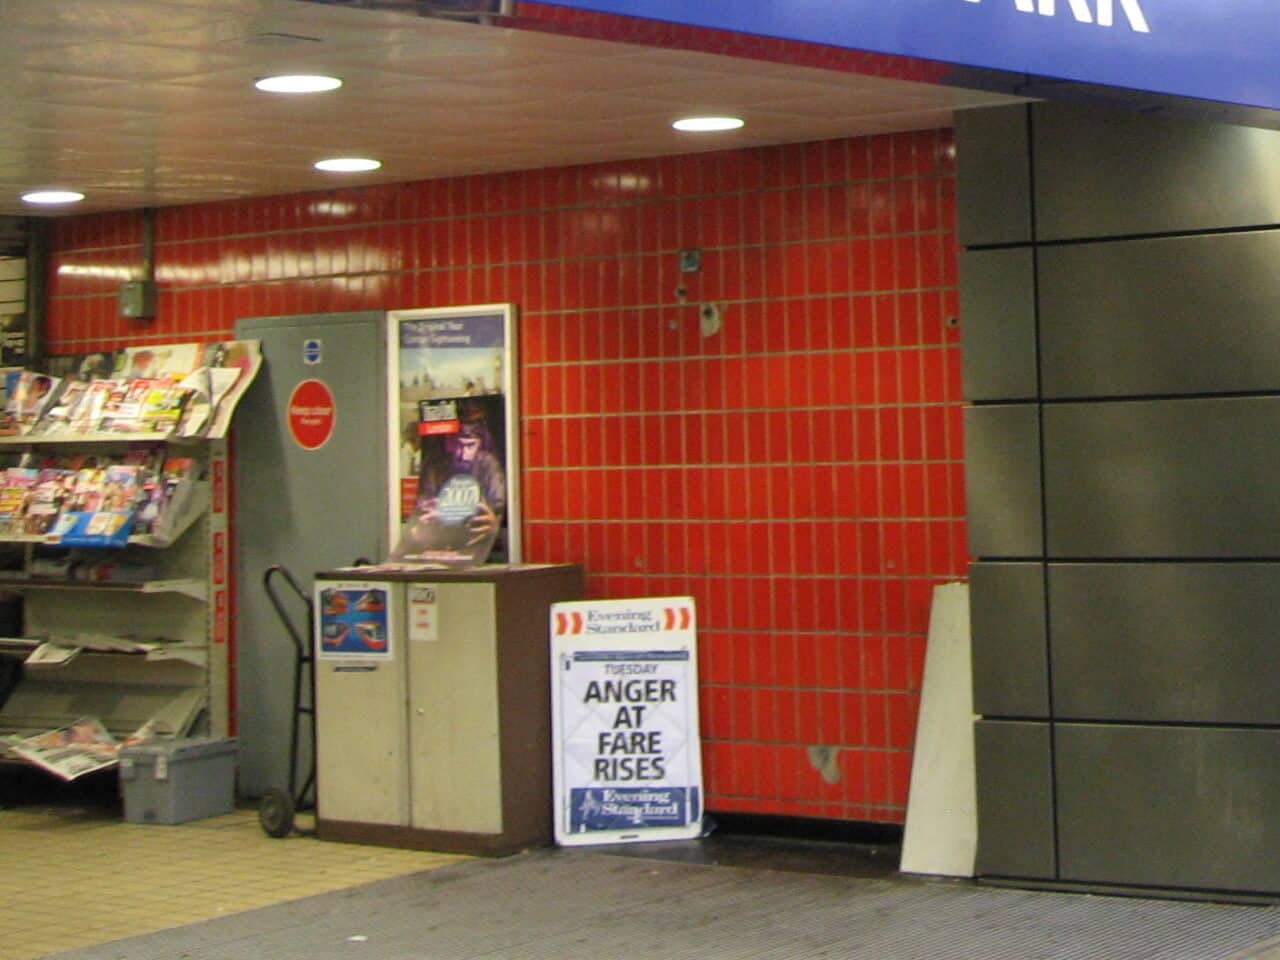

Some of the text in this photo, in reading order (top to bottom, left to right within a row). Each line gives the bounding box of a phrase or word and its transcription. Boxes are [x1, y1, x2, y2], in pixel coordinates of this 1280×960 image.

[587, 609, 654, 622] Evening
[586, 621, 661, 634] Standard
[604, 663, 658, 676] TUESDAY
[583, 678, 677, 704] ANGER
[613, 705, 646, 729] AT
[598, 731, 662, 755] FARE
[593, 756, 666, 781] RISES
[602, 789, 671, 804] Evening
[601, 802, 678, 820] Standard
